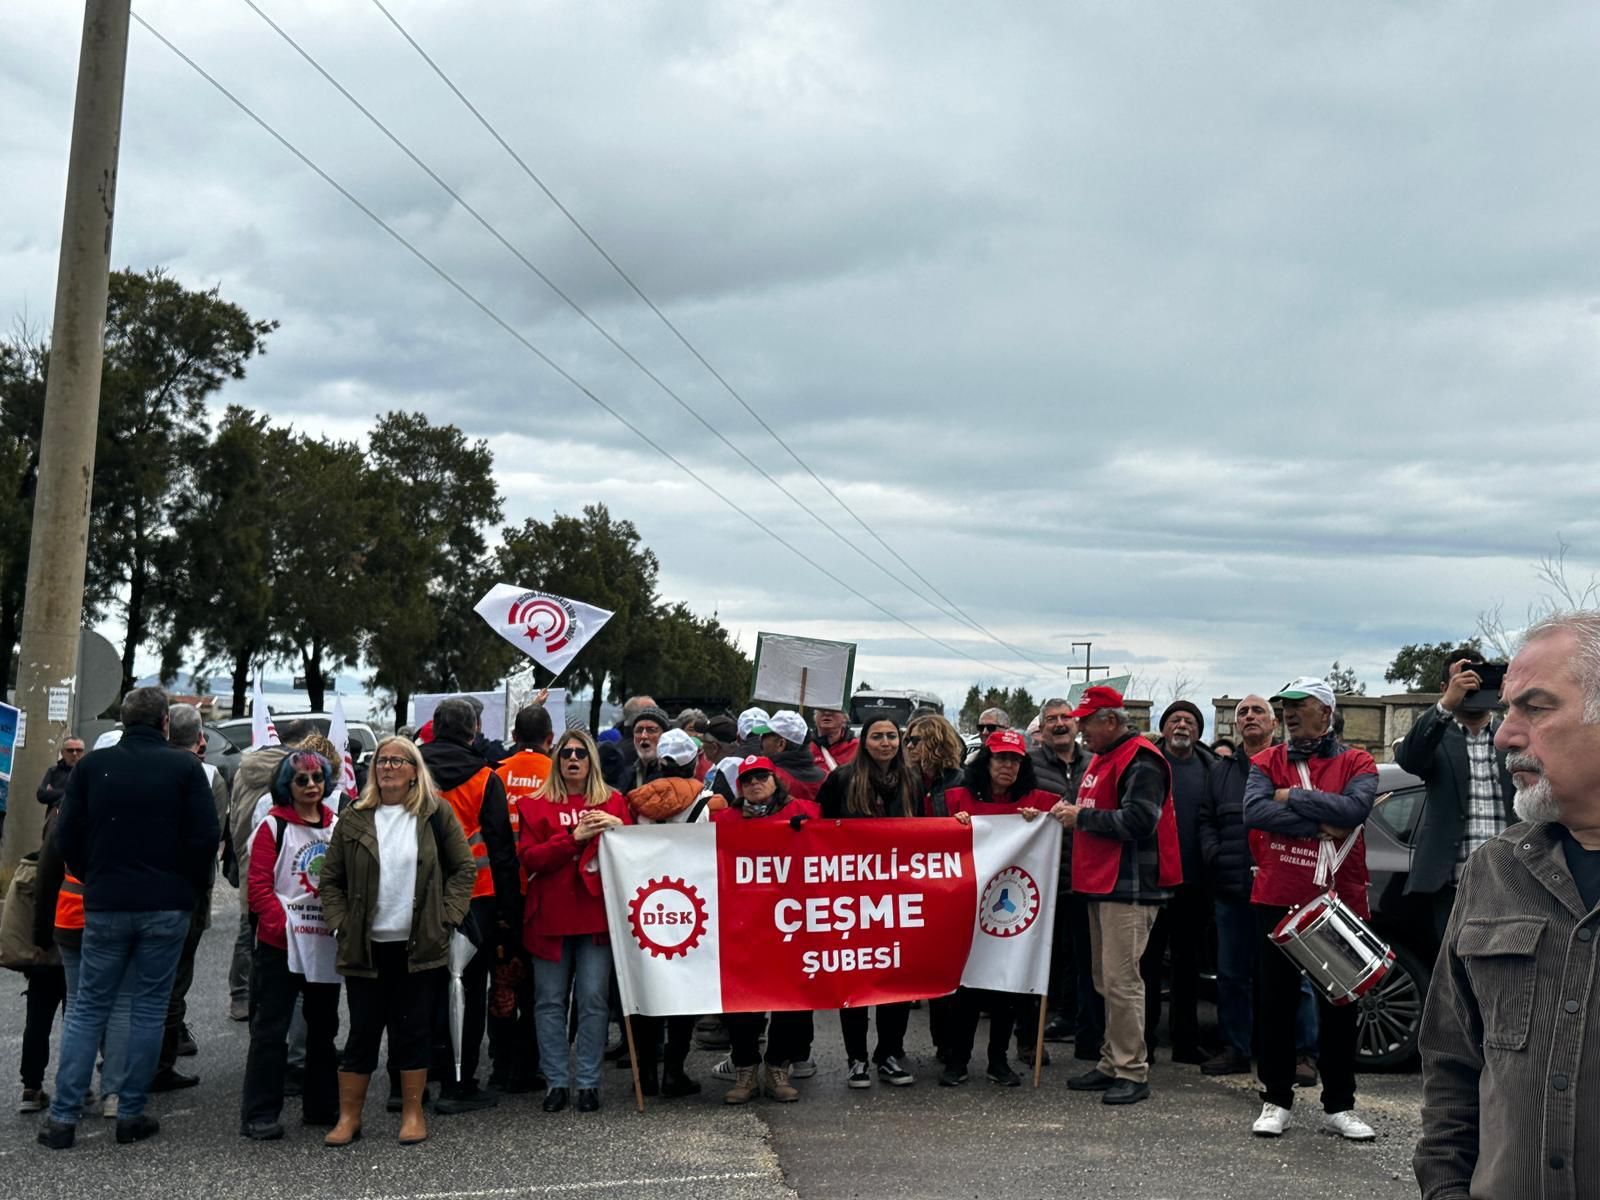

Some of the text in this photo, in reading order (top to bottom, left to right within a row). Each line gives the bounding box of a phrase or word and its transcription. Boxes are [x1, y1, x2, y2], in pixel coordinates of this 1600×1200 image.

[735, 847, 963, 884] DEV EMEKLİ-SEN
[643, 903, 693, 925] DİSK
[774, 893, 925, 942] ÇEŞME
[802, 941, 901, 979] ŞUBESİ
